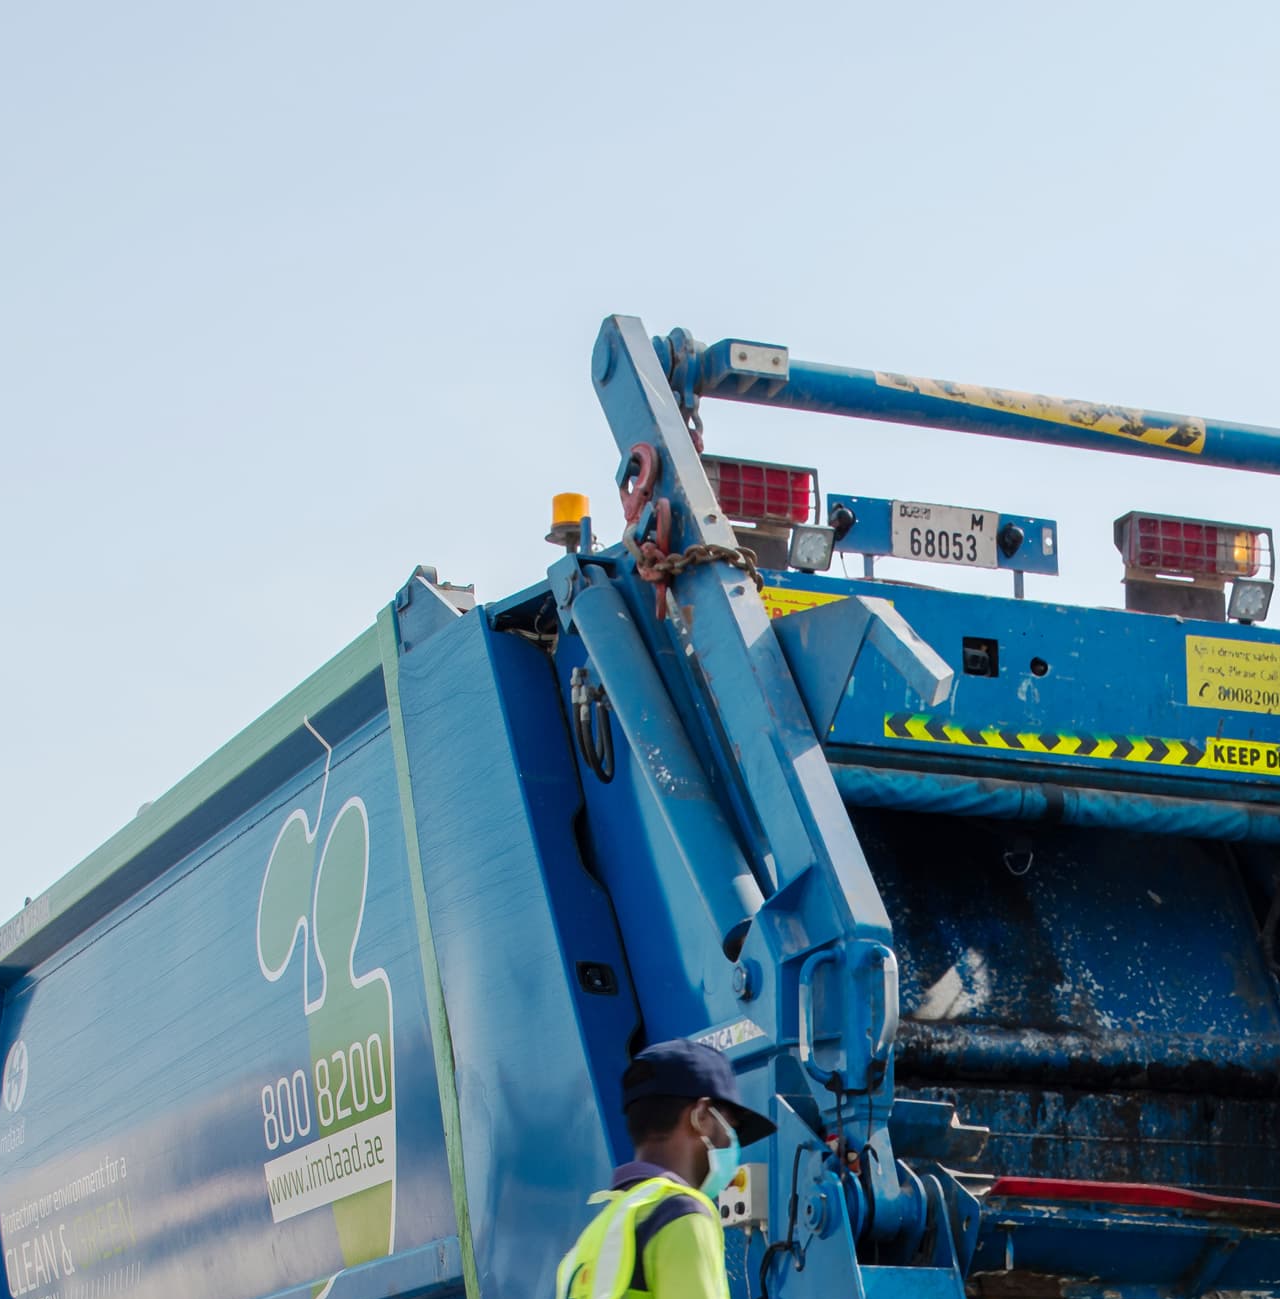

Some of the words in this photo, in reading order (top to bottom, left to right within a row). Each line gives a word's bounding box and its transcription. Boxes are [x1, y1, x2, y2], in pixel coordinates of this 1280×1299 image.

[910, 527, 977, 562] 68053
[971, 513, 984, 532] M
[1217, 685, 1280, 708] 8008200
[1213, 745, 1260, 767] KEEP
[261, 1069, 311, 1151] 800
[315, 1033, 387, 1127] 8200
[1, 1201, 40, 1236] Protecting
[40, 1194, 52, 1218] our
[53, 1162, 106, 1210] environment
[105, 1155, 119, 1185] for
[119, 1156, 127, 1178] a
[268, 1133, 385, 1205] www.imdaad.ae
[5, 1228, 60, 1298] CLEAN
[59, 1223, 76, 1277] &
[73, 1194, 137, 1269] GREEN
